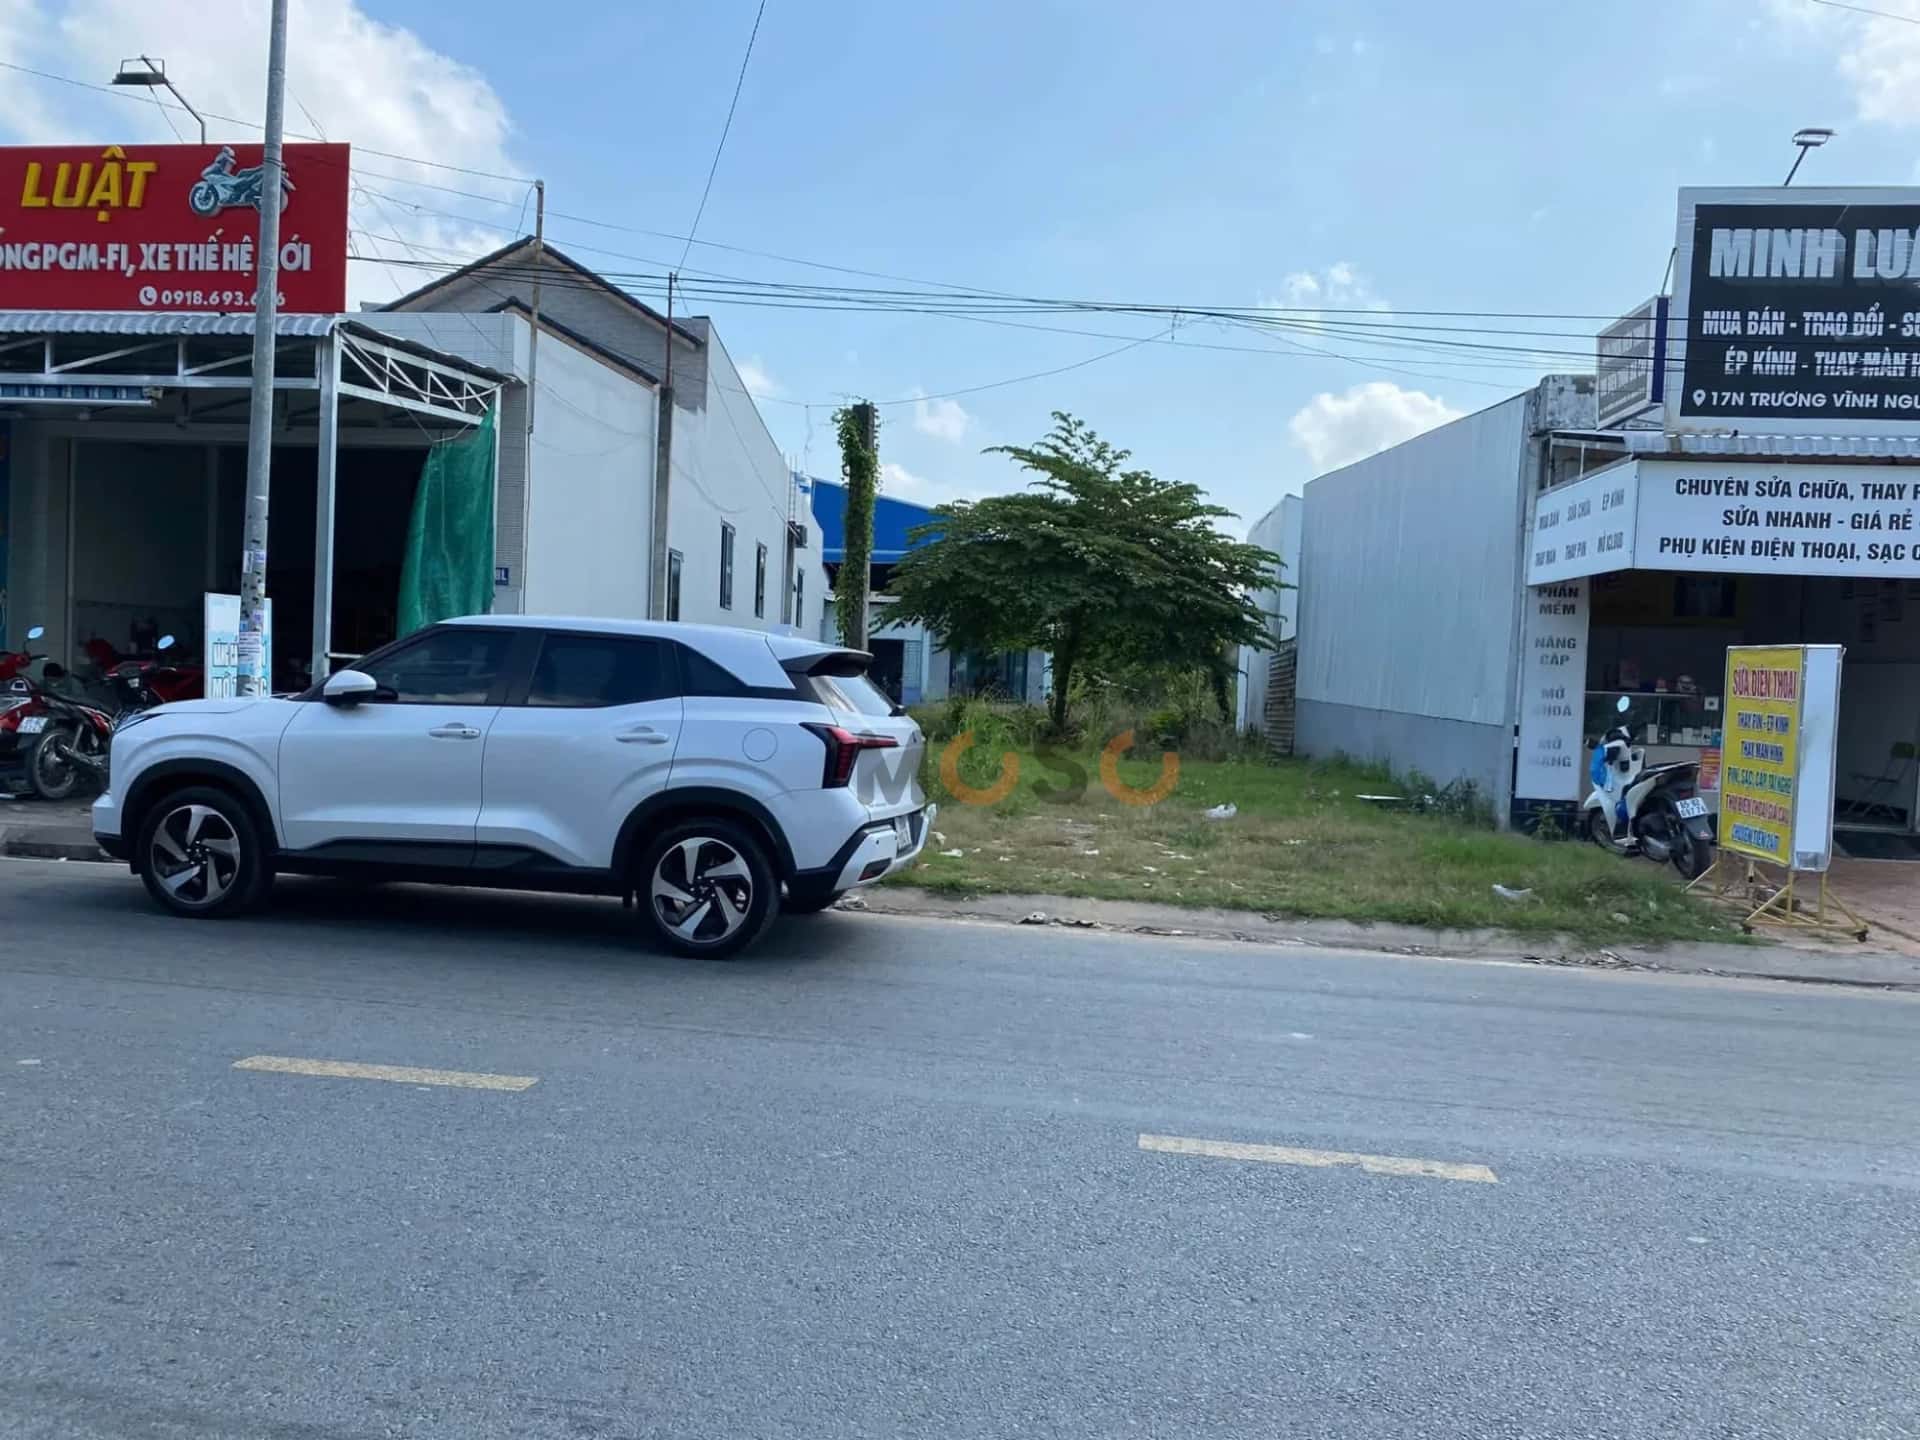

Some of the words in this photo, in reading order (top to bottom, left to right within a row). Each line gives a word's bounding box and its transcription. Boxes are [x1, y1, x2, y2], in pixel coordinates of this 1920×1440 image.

[21, 144, 157, 222] LUẬT
[0, 227, 41, 271] NG
[139, 243, 172, 271] XE
[174, 228, 221, 271] THẾ
[222, 234, 254, 277] HỆ
[280, 234, 312, 271] ỚI
[1709, 228, 1838, 278] MINH
[162, 290, 286, 306] 0918.693.66
[1702, 310, 1742, 335] MUA
[1747, 305, 1785, 335] BÁN
[1803, 311, 1848, 336] TRAO
[1724, 345, 1748, 375] ÉP
[1752, 345, 1797, 376] KÍNH
[1815, 352, 1859, 377] THAY
[1711, 391, 1745, 406] 17N
[1750, 390, 1827, 407] TRƯƠNG
[1832, 390, 1878, 408] VĨNH
[1675, 476, 1749, 496] CHUYÊN
[1755, 475, 1792, 498] SỬA
[1798, 479, 1854, 501] CHỮA,
[1861, 483, 1907, 500] THAY
[1722, 504, 1759, 526] SỬA
[1765, 511, 1832, 529] NHANH
[1851, 510, 1882, 530] GIÁ
[1888, 508, 1912, 530] RẺ
[1659, 537, 1696, 558] PHỤ
[1702, 536, 1745, 559] KIỆN
[1751, 537, 1795, 560] ĐIỆN
[1801, 542, 1860, 563] THOẠI,
[1867, 543, 1905, 564] SẠC
